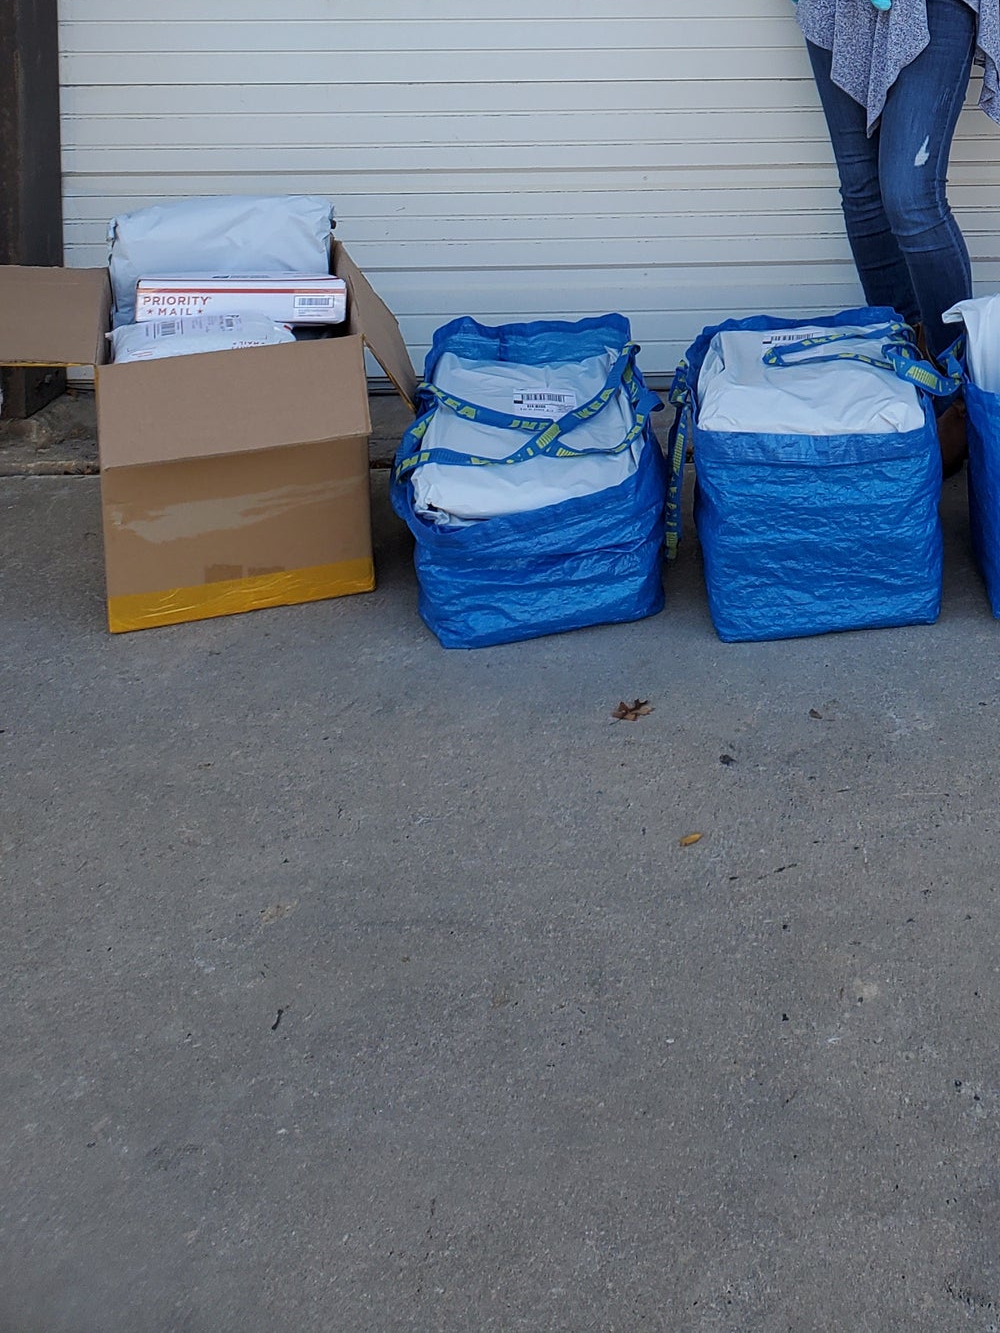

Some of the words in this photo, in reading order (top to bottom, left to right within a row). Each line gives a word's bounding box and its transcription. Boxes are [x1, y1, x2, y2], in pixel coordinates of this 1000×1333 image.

[143, 296, 212, 306] PRIORITY
[158, 308, 192, 316] MAIL
[571, 387, 616, 420] IKEA
